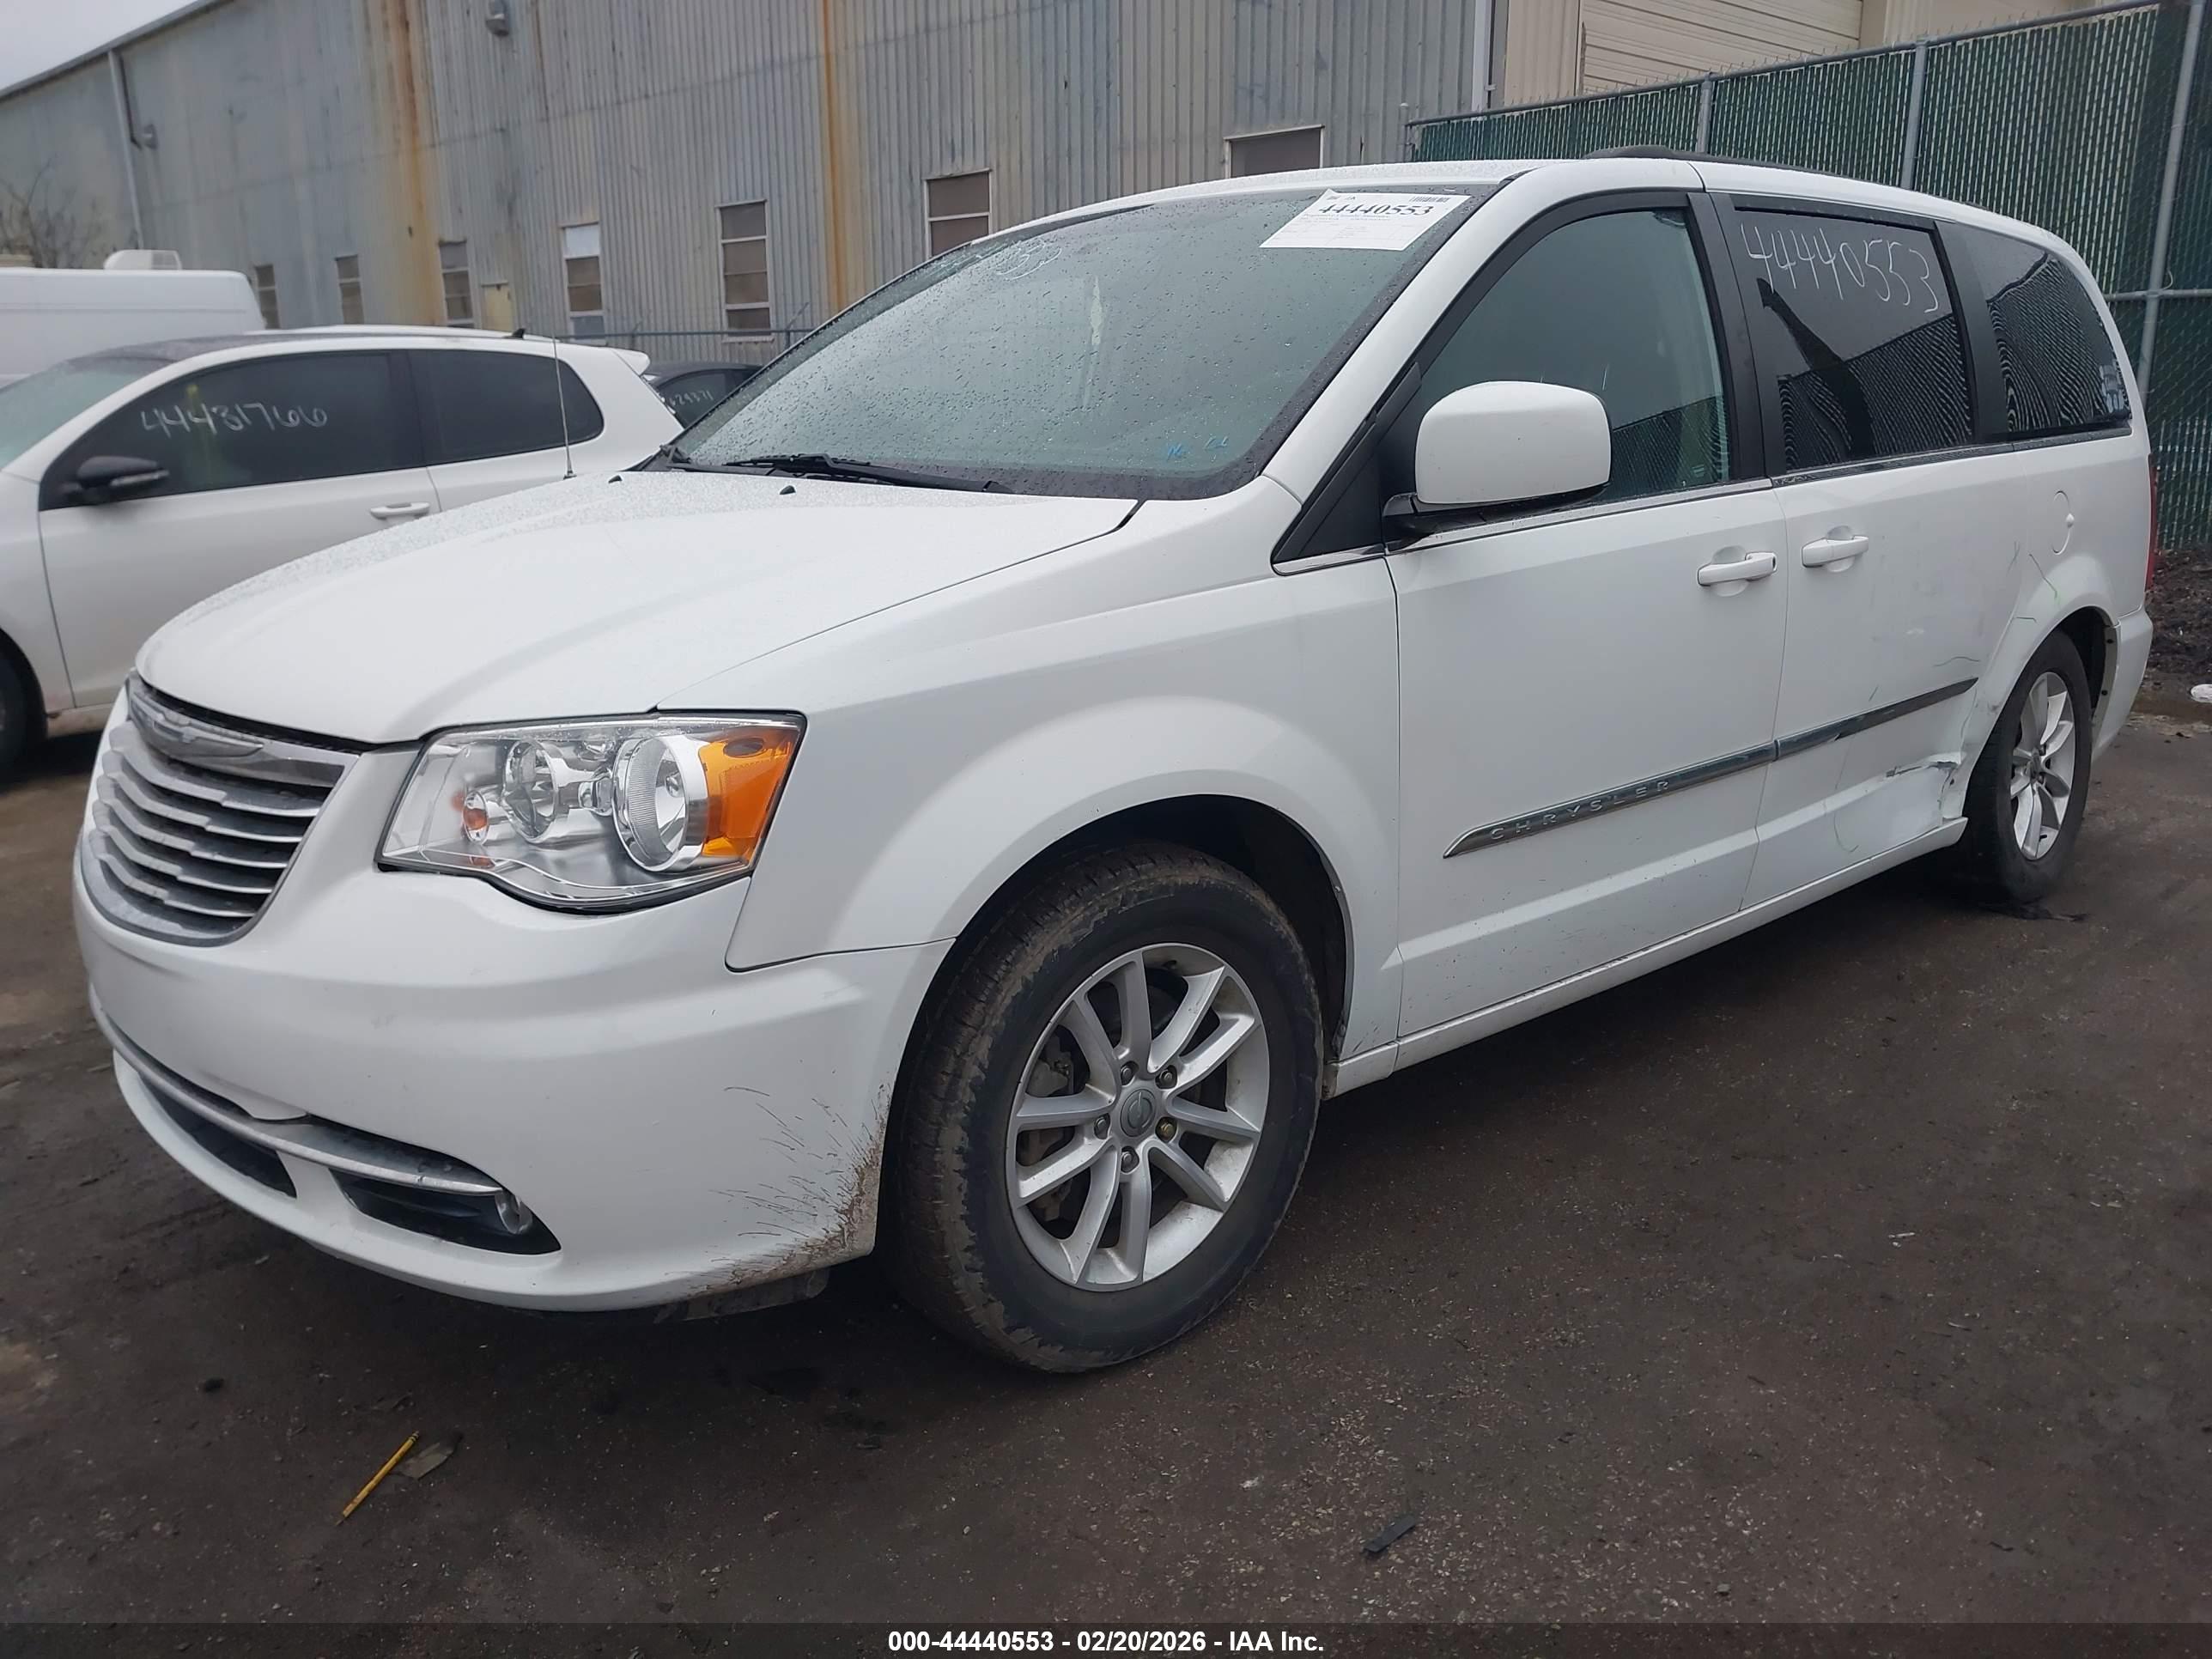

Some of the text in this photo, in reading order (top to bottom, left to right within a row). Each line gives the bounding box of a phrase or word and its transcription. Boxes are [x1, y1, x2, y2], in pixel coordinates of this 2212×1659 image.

[1319, 204, 1434, 216] 44440553
[1741, 223, 1939, 313] 44440553
[1491, 781, 1669, 840] CHRYSLER
